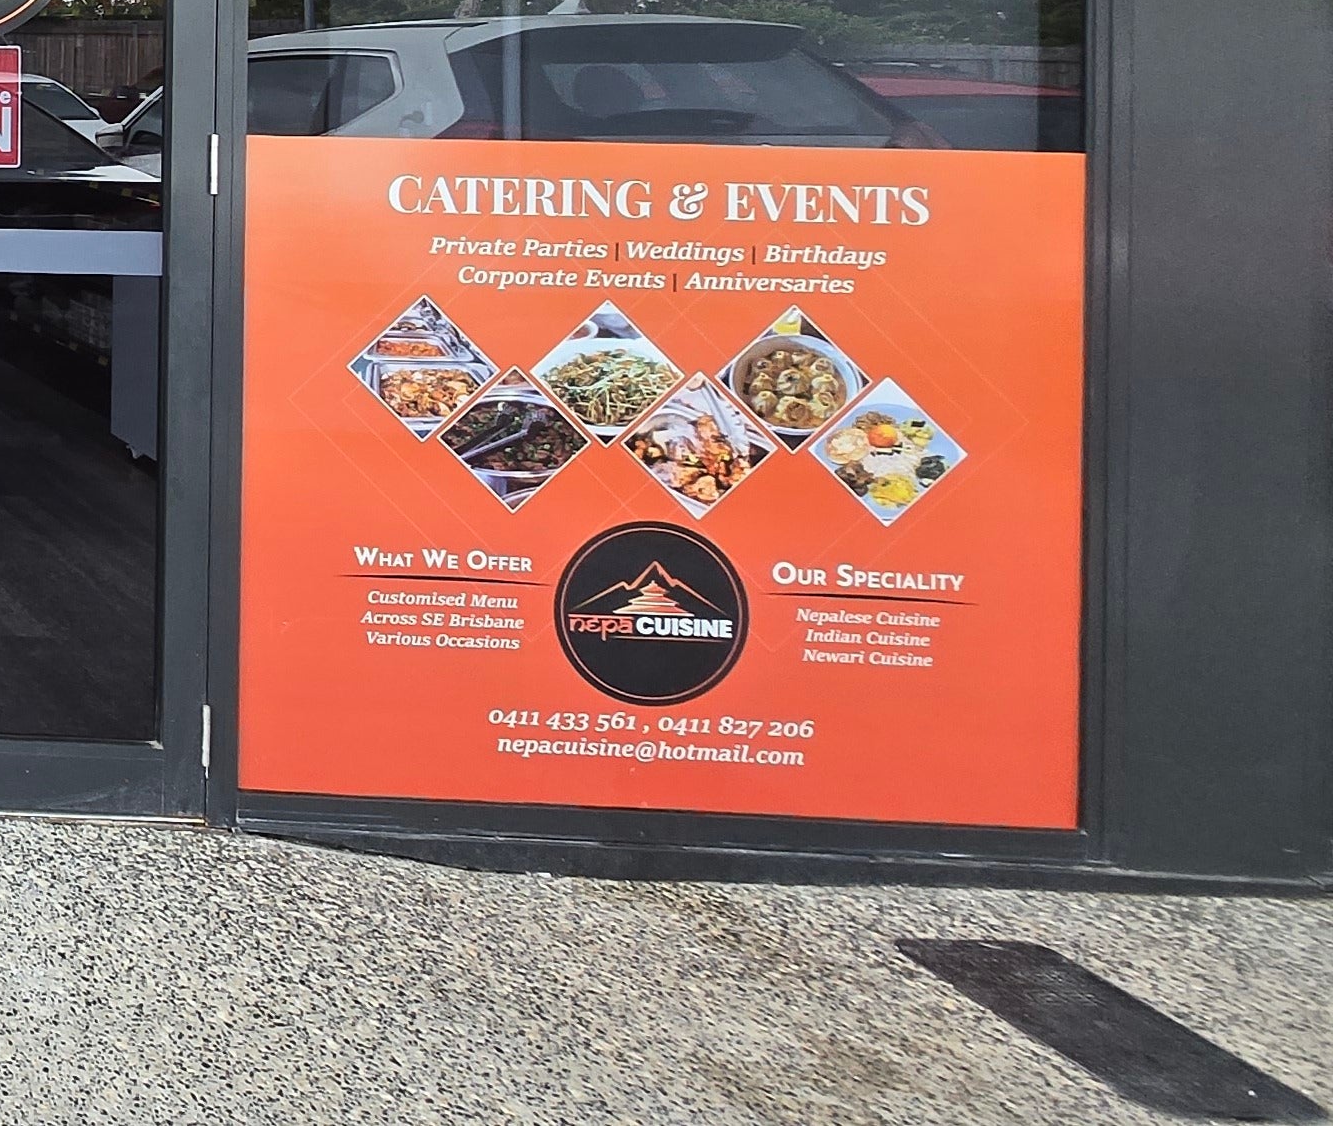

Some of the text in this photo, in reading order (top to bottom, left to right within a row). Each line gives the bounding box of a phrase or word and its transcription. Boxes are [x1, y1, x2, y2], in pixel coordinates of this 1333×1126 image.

[388, 173, 931, 227] CATERING & EVENTS
[429, 236, 887, 270] Private Parties Weddings Birthdays
[457, 266, 855, 295] Corporate Events Anniversaries
[366, 589, 519, 610] Customised Menu
[360, 610, 525, 631] Across SE Brisbane
[568, 614, 733, 641] nepa CUISINE
[796, 608, 941, 629] Nepalese Cuisine
[366, 631, 521, 651] Various Occasions
[805, 627, 931, 648] Indian Cuisine
[802, 648, 933, 667] Newari Cuisine
[487, 707, 540, 729] 0411
[546, 710, 590, 732] 433
[594, 712, 638, 733] 561
[657, 714, 712, 737] 0411
[717, 715, 764, 740] 827
[768, 717, 815, 741] 206
[497, 734, 805, 767] nepacuisine@hotmail.com
